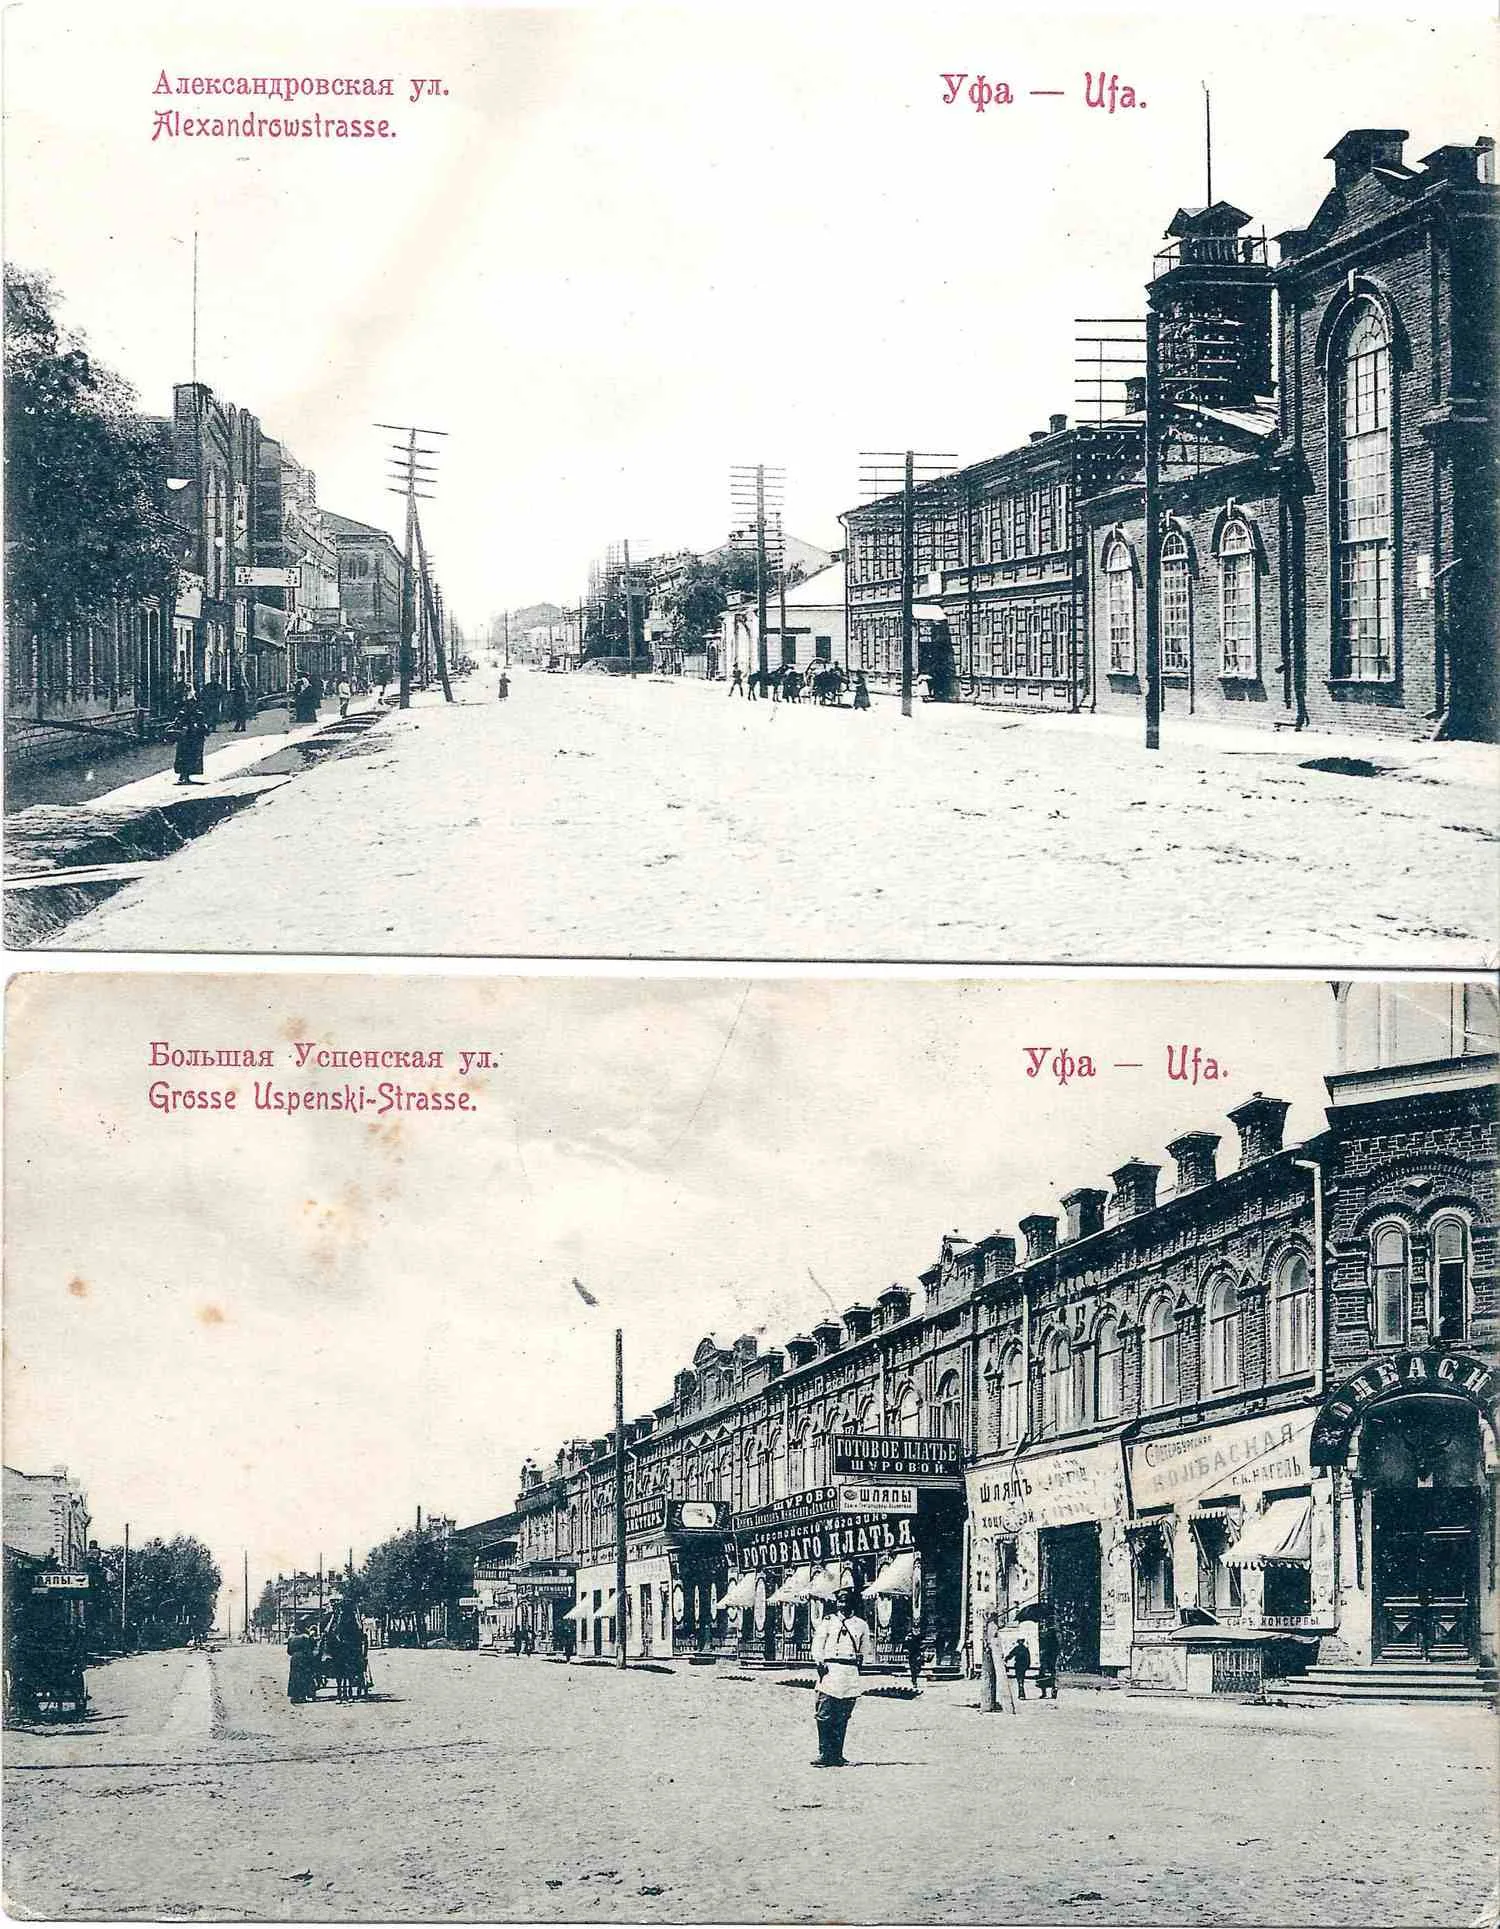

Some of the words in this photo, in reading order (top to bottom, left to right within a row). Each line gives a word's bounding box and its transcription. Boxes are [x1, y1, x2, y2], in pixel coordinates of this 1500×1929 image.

[836, 1438, 900, 1460] ГОТОВОЕ
[903, 1441, 957, 1462] ПЛАТЬЕ
[859, 1488, 912, 1503] ШЛЯПЫ
[979, 1478, 1033, 1503] ШЛЯПЪ
[743, 1536, 822, 1569] ГОТОВАГО
